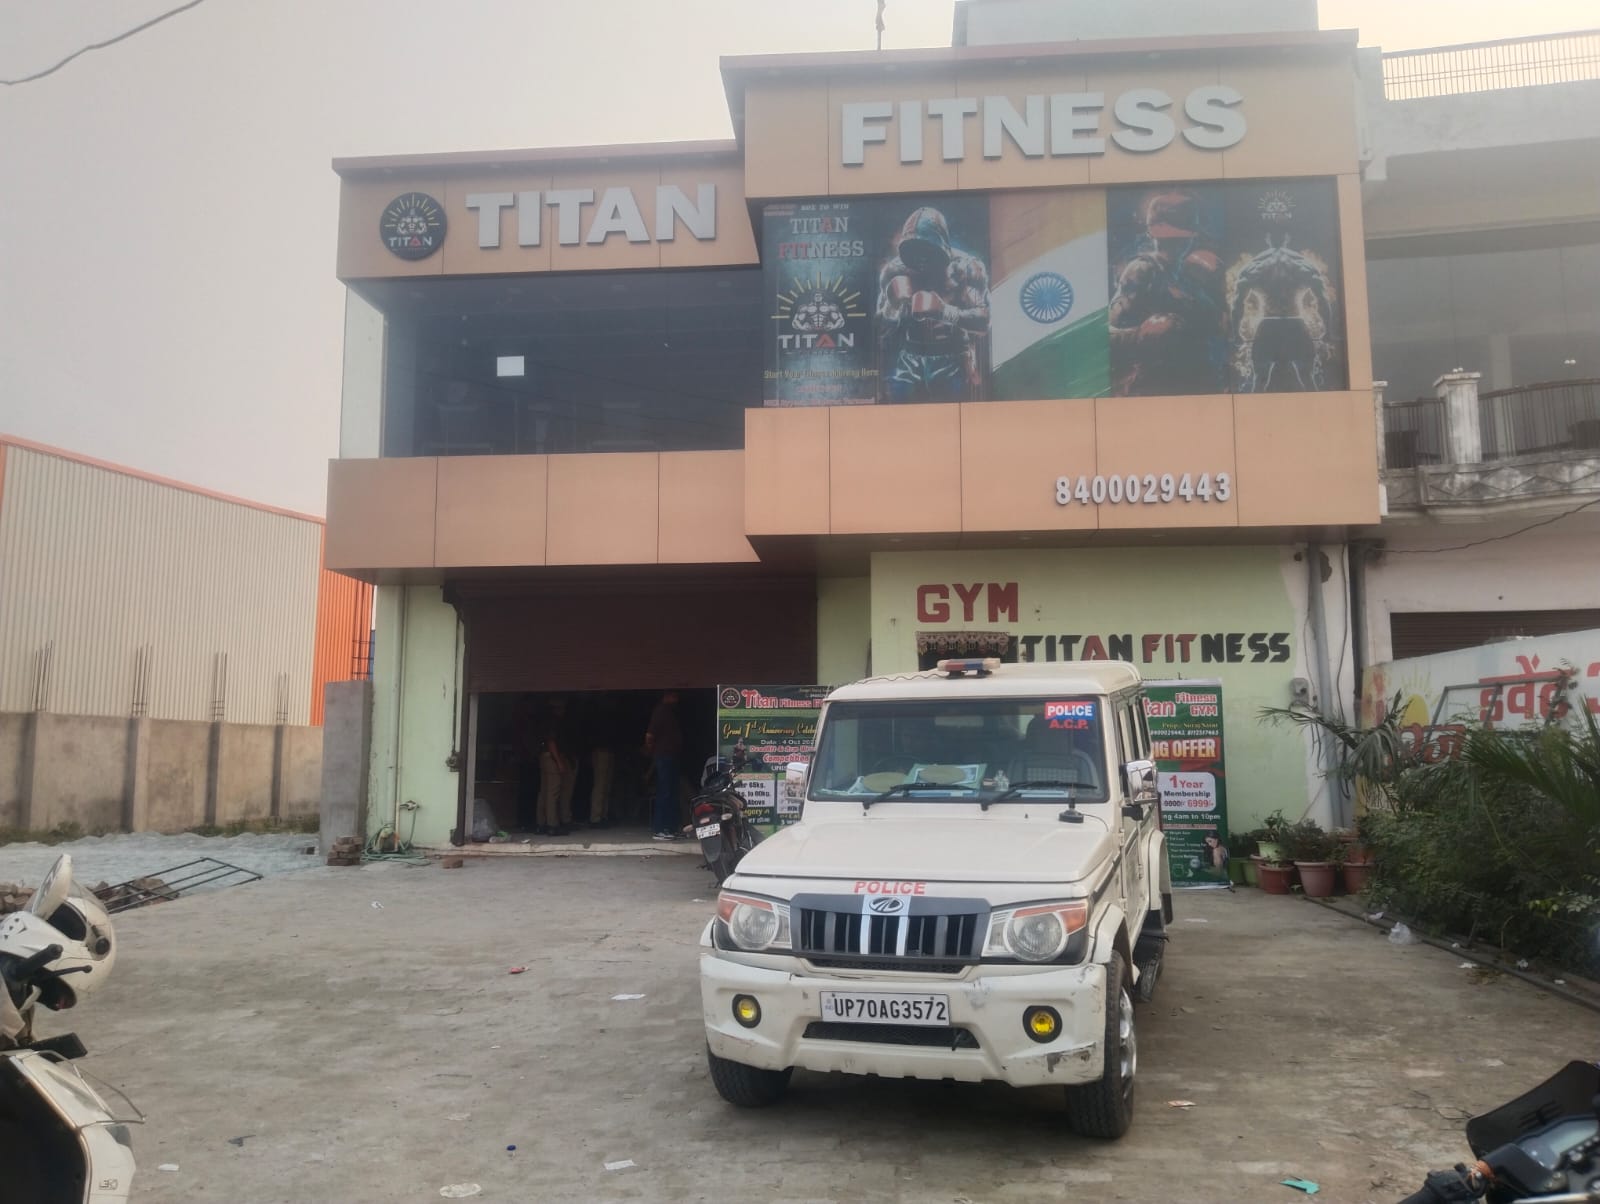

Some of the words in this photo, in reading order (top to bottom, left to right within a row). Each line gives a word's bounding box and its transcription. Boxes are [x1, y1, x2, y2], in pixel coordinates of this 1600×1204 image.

[841, 85, 1247, 166] FITNESS
[465, 183, 717, 249] TITAN
[789, 216, 849, 235] TITAN
[388, 235, 433, 248] TITAN
[777, 240, 865, 260] FITNESS
[777, 332, 855, 350] TITAN
[1055, 472, 1231, 505] 8400029443
[916, 582, 1019, 623] GYM
[1020, 633, 1133, 663] TITAN
[1141, 632, 1290, 663] FITNESS
[741, 688, 779, 709] Titan
[1142, 697, 1176, 717] tan
[1175, 692, 1217, 704] Fitness
[1047, 705, 1093, 716] POLICE
[1190, 704, 1218, 717] GYM
[1172, 739, 1216, 758] OFFER
[1169, 774, 1178, 789] 1
[1179, 780, 1204, 789] Year
[1163, 790, 1211, 798] Membership
[1201, 813, 1221, 821] 10pm
[854, 881, 927, 895] POLICE
[833, 997, 947, 1022] UP70AG3572
